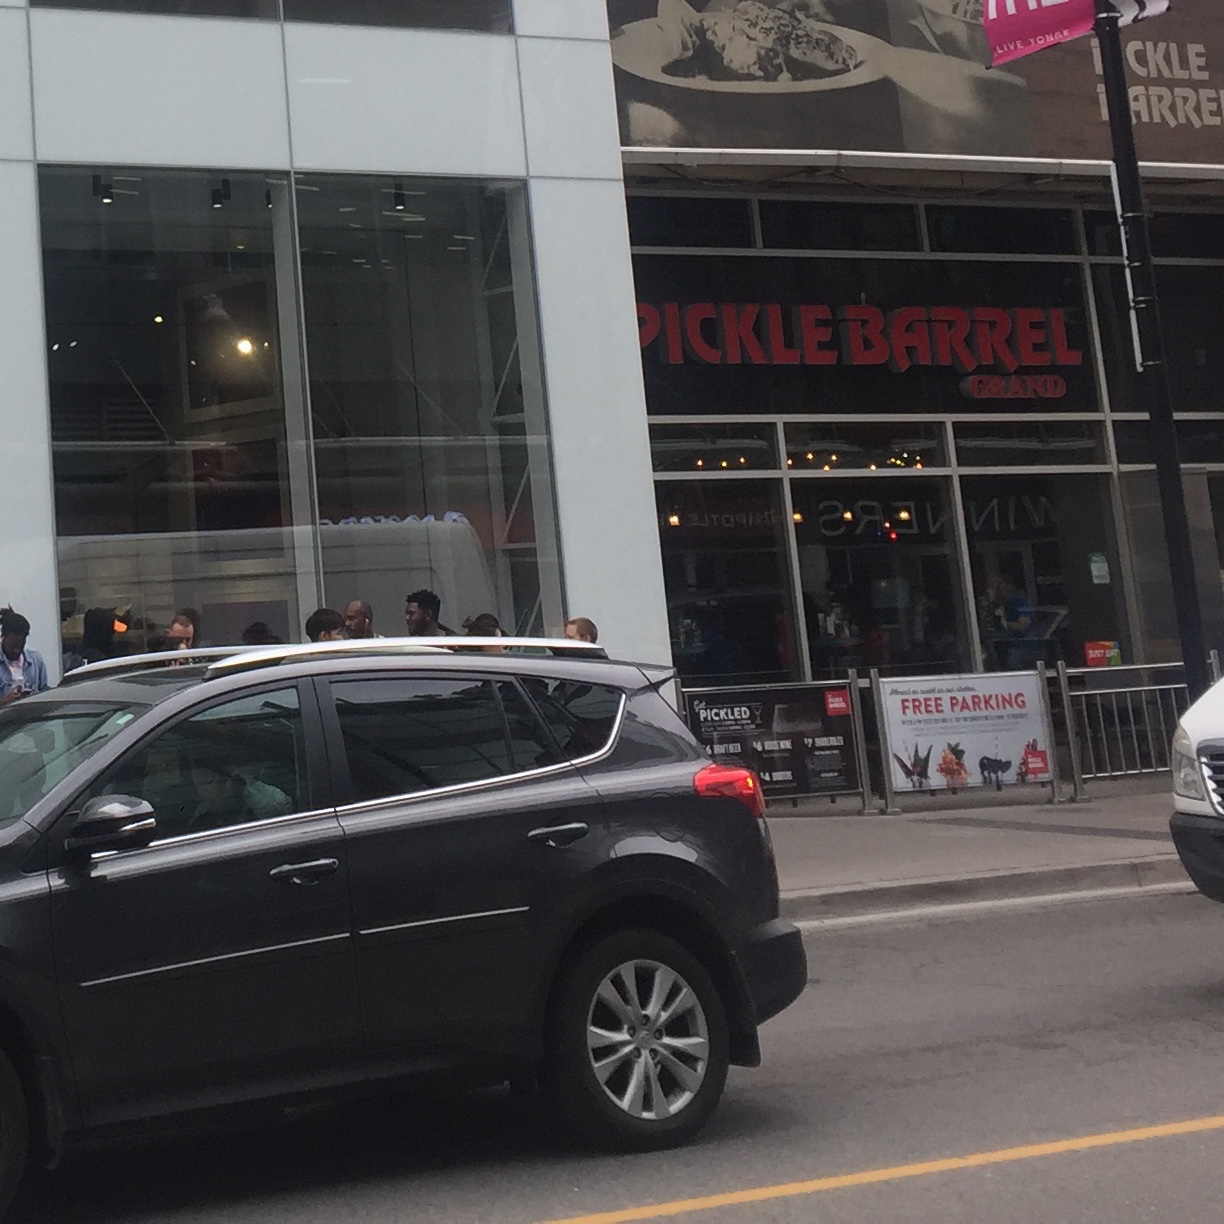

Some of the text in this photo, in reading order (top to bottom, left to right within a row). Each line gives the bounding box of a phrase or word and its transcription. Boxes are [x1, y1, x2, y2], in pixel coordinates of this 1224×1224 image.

[1028, 29, 1070, 46] YONGE
[1090, 38, 1210, 80] CKLE
[844, 304, 1083, 373] BARREL
[971, 374, 1067, 399] GRAND
[699, 706, 750, 721] PICKLED
[900, 692, 1027, 715] FREE PARKING
